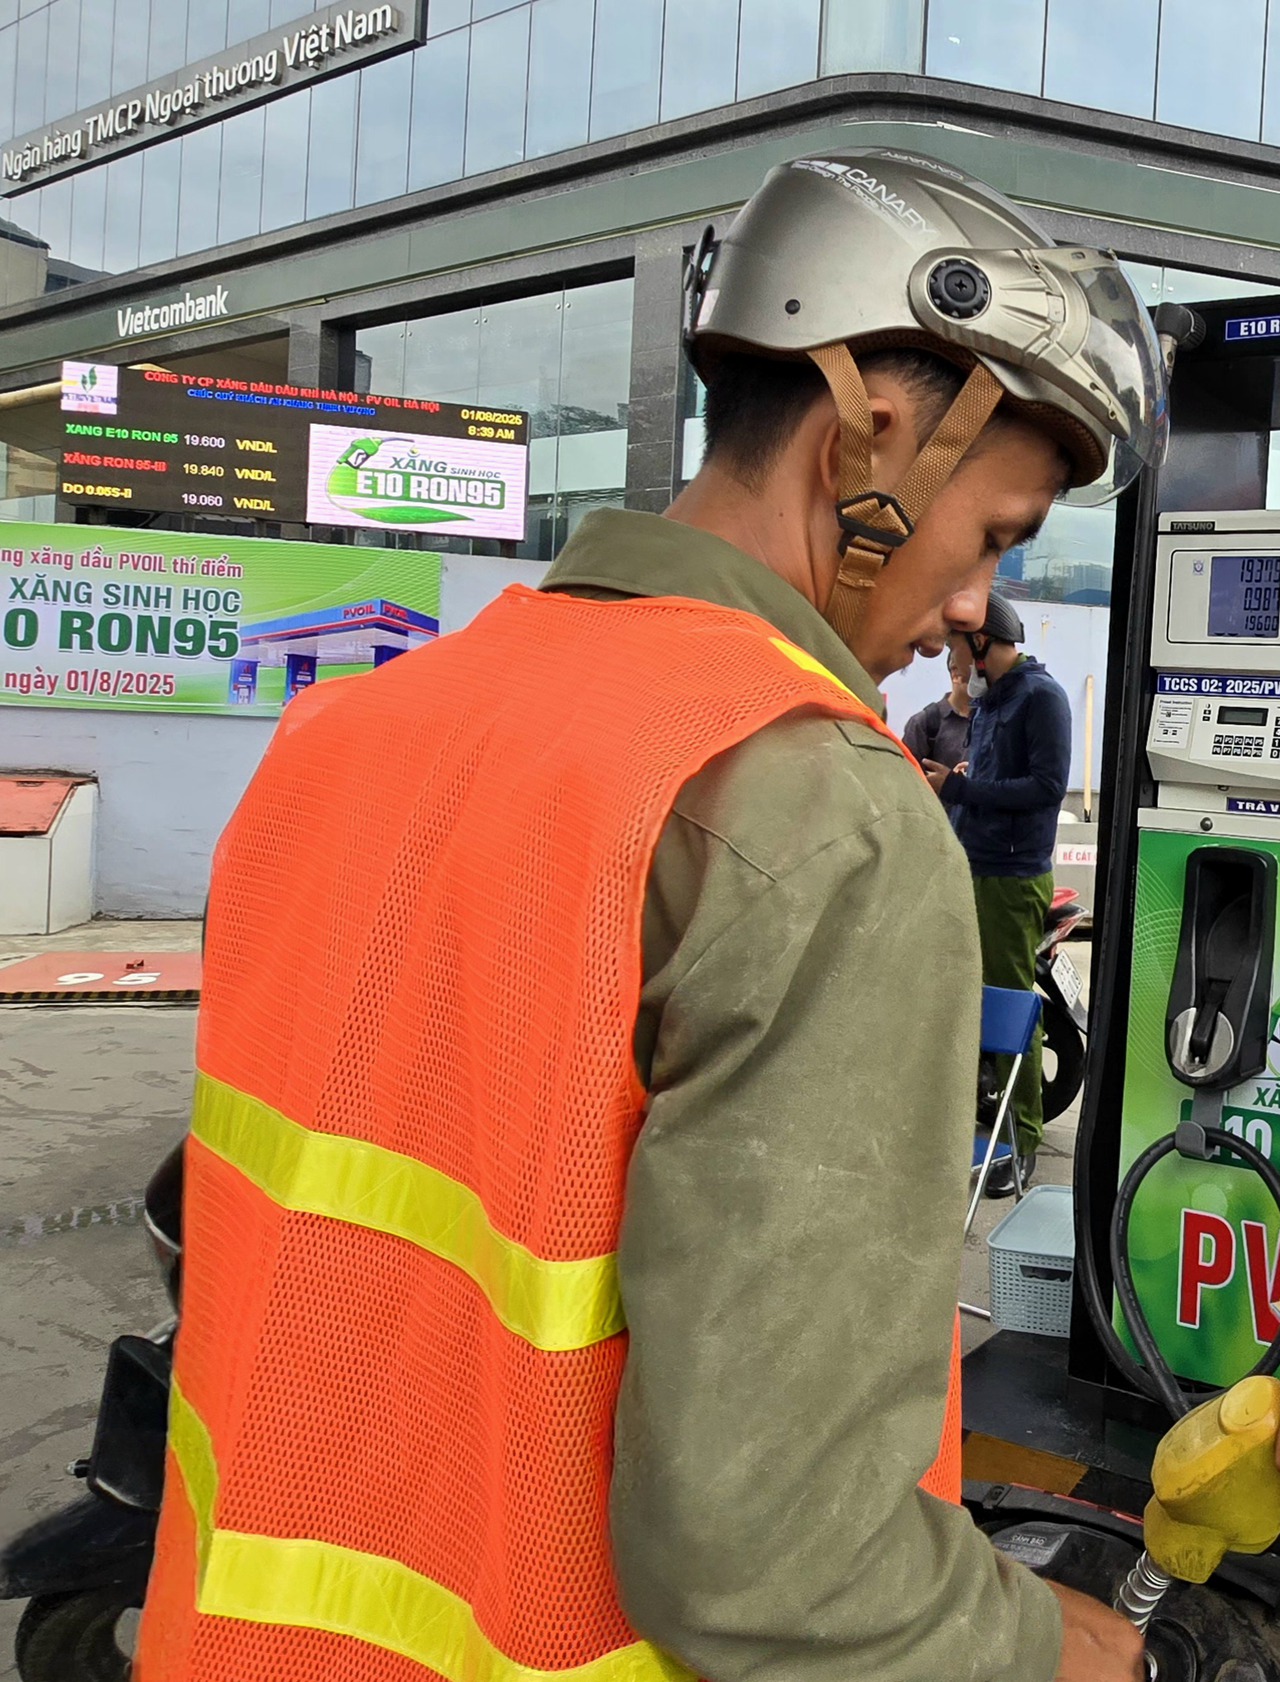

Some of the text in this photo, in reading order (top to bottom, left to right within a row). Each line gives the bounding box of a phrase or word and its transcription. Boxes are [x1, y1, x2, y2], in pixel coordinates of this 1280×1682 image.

[2, 4, 391, 181] Ngân hàng TMCP Ngoại thương Việt Nam
[846, 168, 936, 236] CANARY
[117, 285, 229, 337] Vietcombank
[1240, 319, 1266, 337] E10
[106, 427, 128, 440] E10
[131, 430, 161, 443] RON
[163, 433, 178, 444] 95
[185, 434, 225, 448] 19.600
[236, 439, 277, 453] VND/L
[468, 425, 515, 440] 8:39 AM
[103, 457, 134, 469] RON
[183, 463, 224, 477] 19.840
[235, 468, 276, 482] VND/L
[450, 467, 476, 477] SINH
[62, 483, 84, 495] DO
[182, 493, 223, 507] 19.060
[234, 497, 275, 511] VND/L
[357, 471, 502, 506] E10 RON95
[1172, 522, 1213, 531] TATSUNO
[30, 547, 74, 571] xăng
[81, 546, 112, 569] dầu
[119, 553, 167, 573] PVOIL
[172, 557, 196, 575] thí
[201, 555, 242, 578] điểm
[9, 573, 240, 618] XĂNG SINH HỌC
[343, 604, 376, 619] PVOIL
[59, 610, 239, 658] RON95
[5, 666, 175, 696] ngày 01/8/2025
[1164, 678, 1198, 692] TCCS
[1201, 679, 1222, 692] 02:
[1236, 800, 1266, 811] TRẢ
[54, 972, 161, 986] 95
[1214, 1115, 1273, 1160] 10
